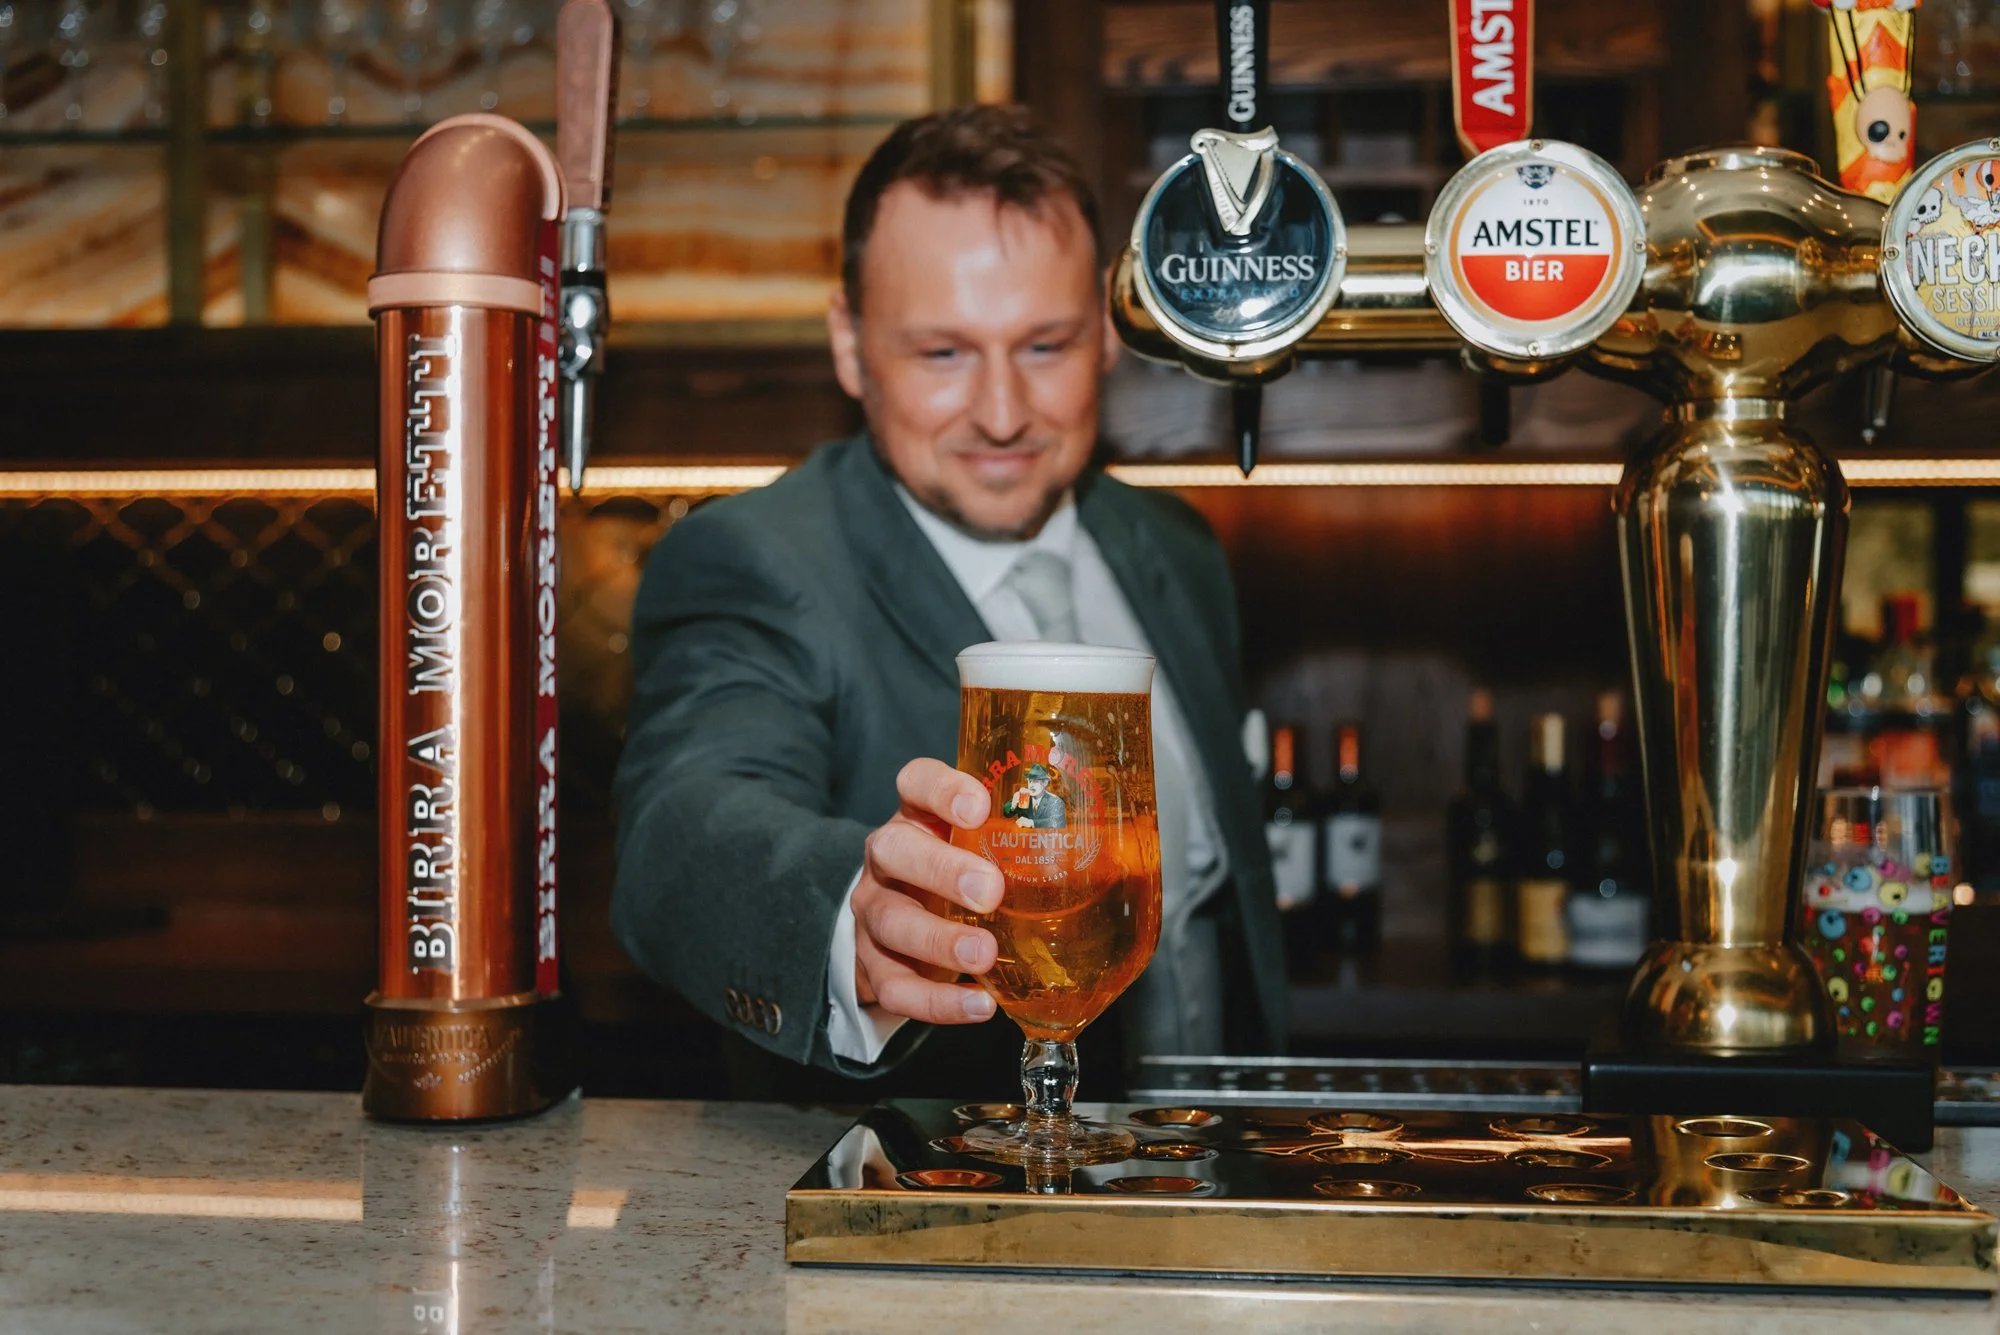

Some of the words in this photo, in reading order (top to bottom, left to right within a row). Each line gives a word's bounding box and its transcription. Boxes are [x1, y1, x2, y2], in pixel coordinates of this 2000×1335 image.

[1228, 5, 1256, 122] GUINNESS
[1471, 0, 1515, 117] AMST
[1472, 219, 1599, 247] AMSTEL
[1161, 254, 1315, 284] GUINNESS
[1505, 260, 1563, 281] BIER
[1181, 287, 1241, 300] EXTRA
[1250, 286, 1300, 299] COD
[1932, 286, 2000, 313] SESSI
[408, 333, 459, 695] MORETTI
[538, 354, 555, 697] MORETTI
[408, 723, 457, 975] BIRRA
[538, 726, 555, 962] BIRRA
[991, 831, 1085, 849] L'AUTENTICA
[1015, 855, 1032, 865] DAL
